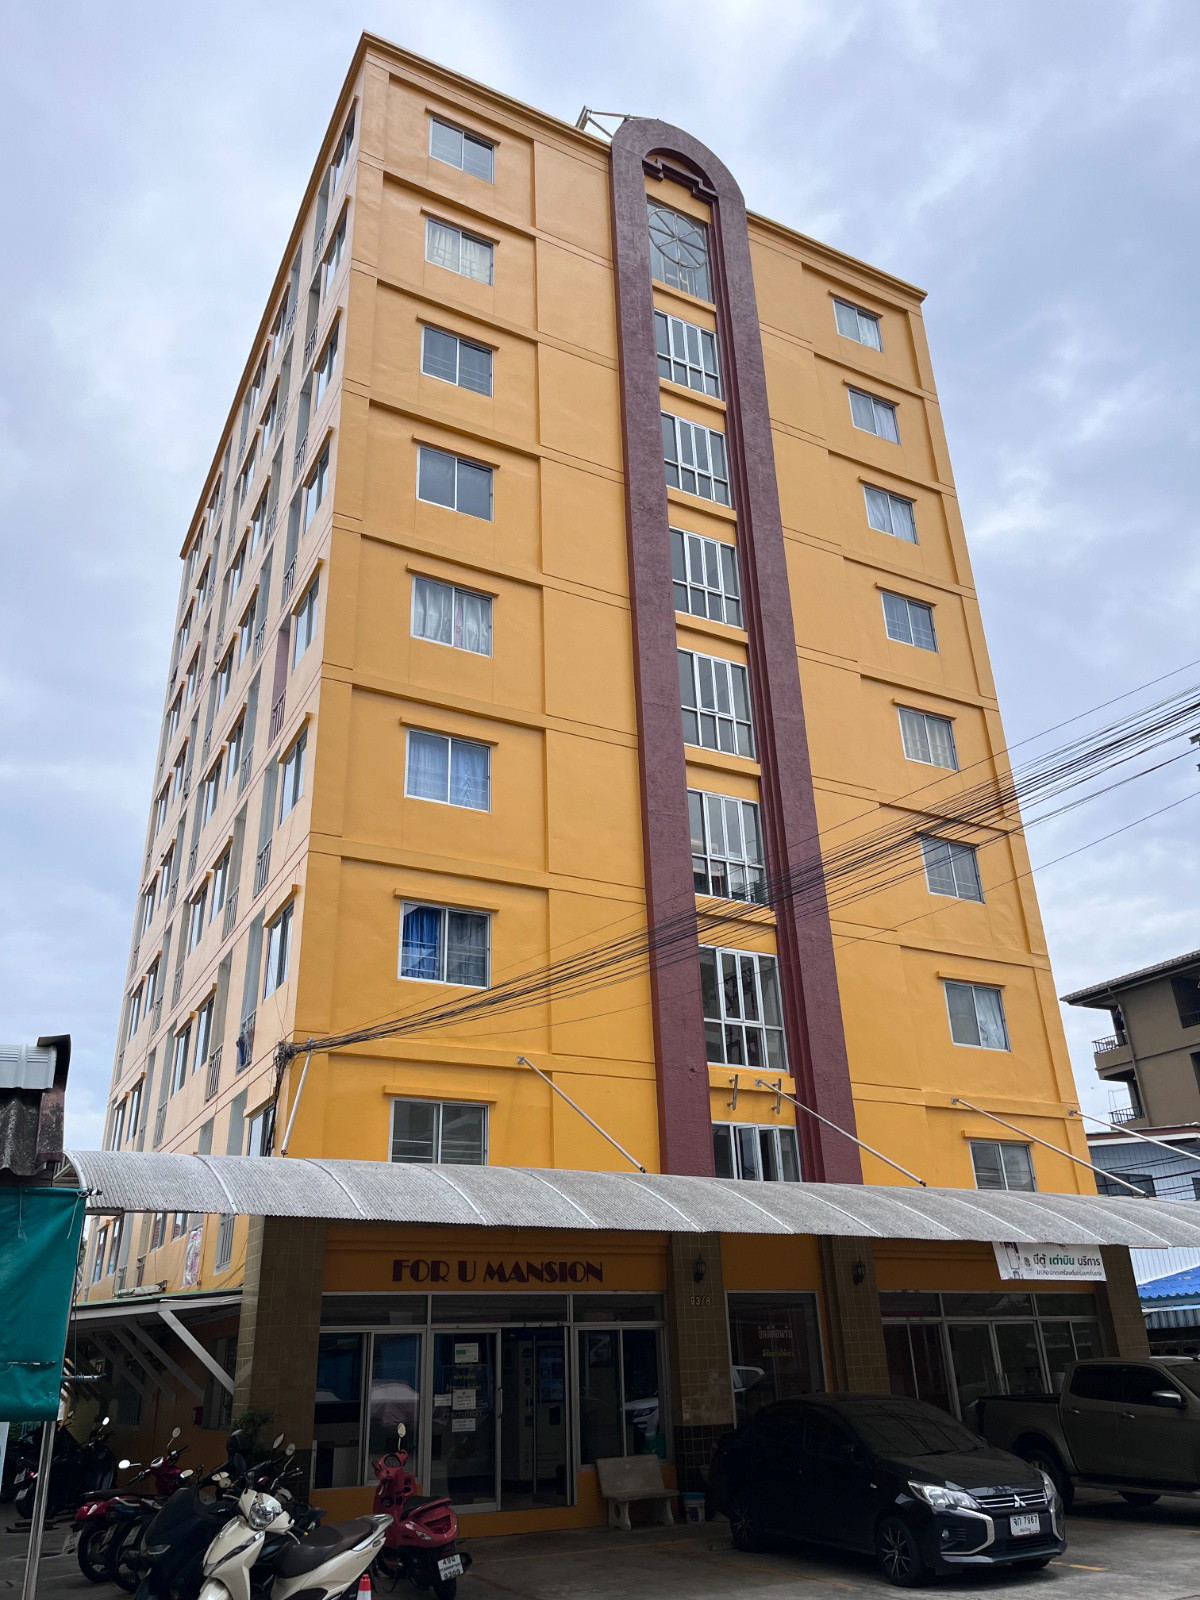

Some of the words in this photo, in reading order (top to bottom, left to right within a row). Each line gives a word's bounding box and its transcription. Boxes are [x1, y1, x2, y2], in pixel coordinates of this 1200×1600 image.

[1049, 1254, 1075, 1265] เต่าบิน
[1077, 1255, 1101, 1266] บริการ
[392, 1259, 449, 1282] FOR
[457, 1260, 476, 1282] U
[483, 1260, 603, 1282] MANSION
[690, 1295, 711, 1306] 93/8
[1024, 1515, 1038, 1524] 7967
